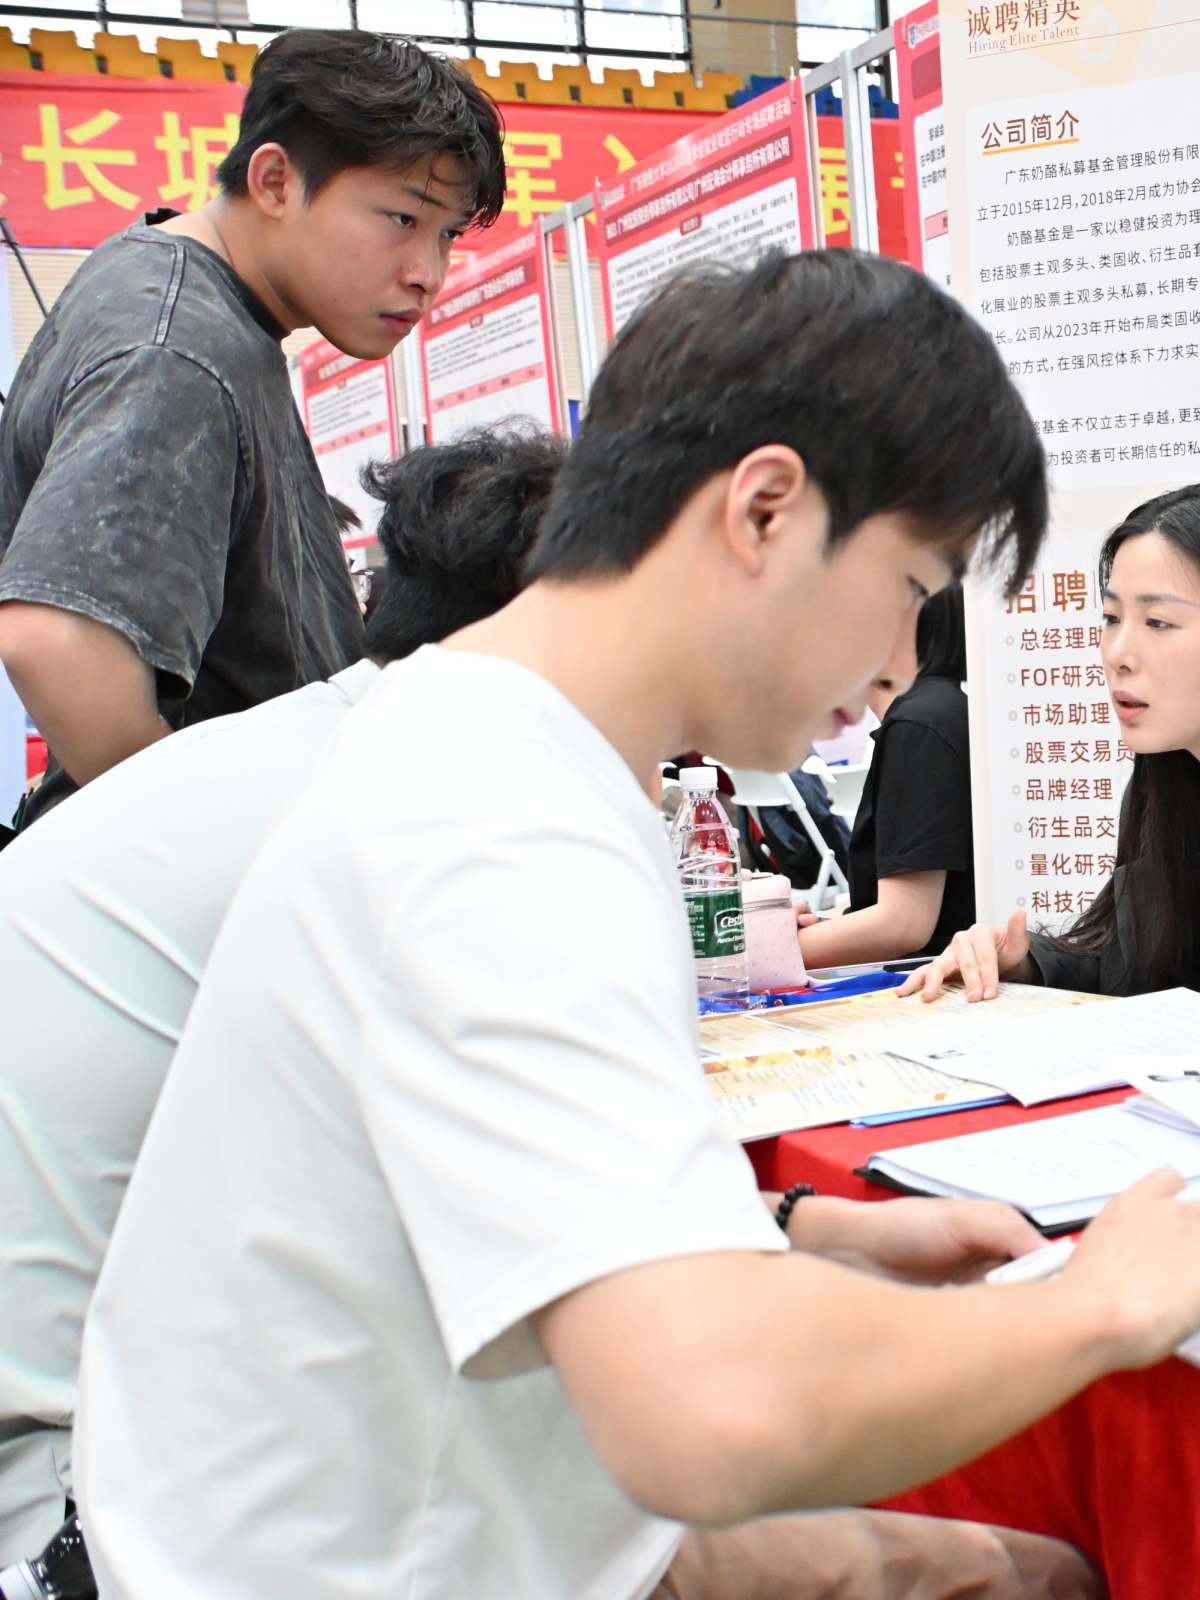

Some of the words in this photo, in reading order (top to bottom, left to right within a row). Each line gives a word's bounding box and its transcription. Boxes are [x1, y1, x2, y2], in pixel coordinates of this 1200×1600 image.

[966, 0, 1081, 37] 诚聘精英
[969, 37, 1006, 53] Hiring
[1009, 31, 1037, 47] Elite
[1040, 25, 1079, 41] Talent
[981, 109, 1080, 150] 公司简介
[1053, 570, 1088, 612] 聘
[1020, 664, 1105, 689] FOF研究
[1023, 702, 1111, 727] 市场助理
[1025, 739, 1135, 764] 股票交易员
[1026, 778, 1113, 801] 品牌经理
[1029, 815, 1116, 839] 衍生品交
[1029, 853, 1117, 877] 量化研究
